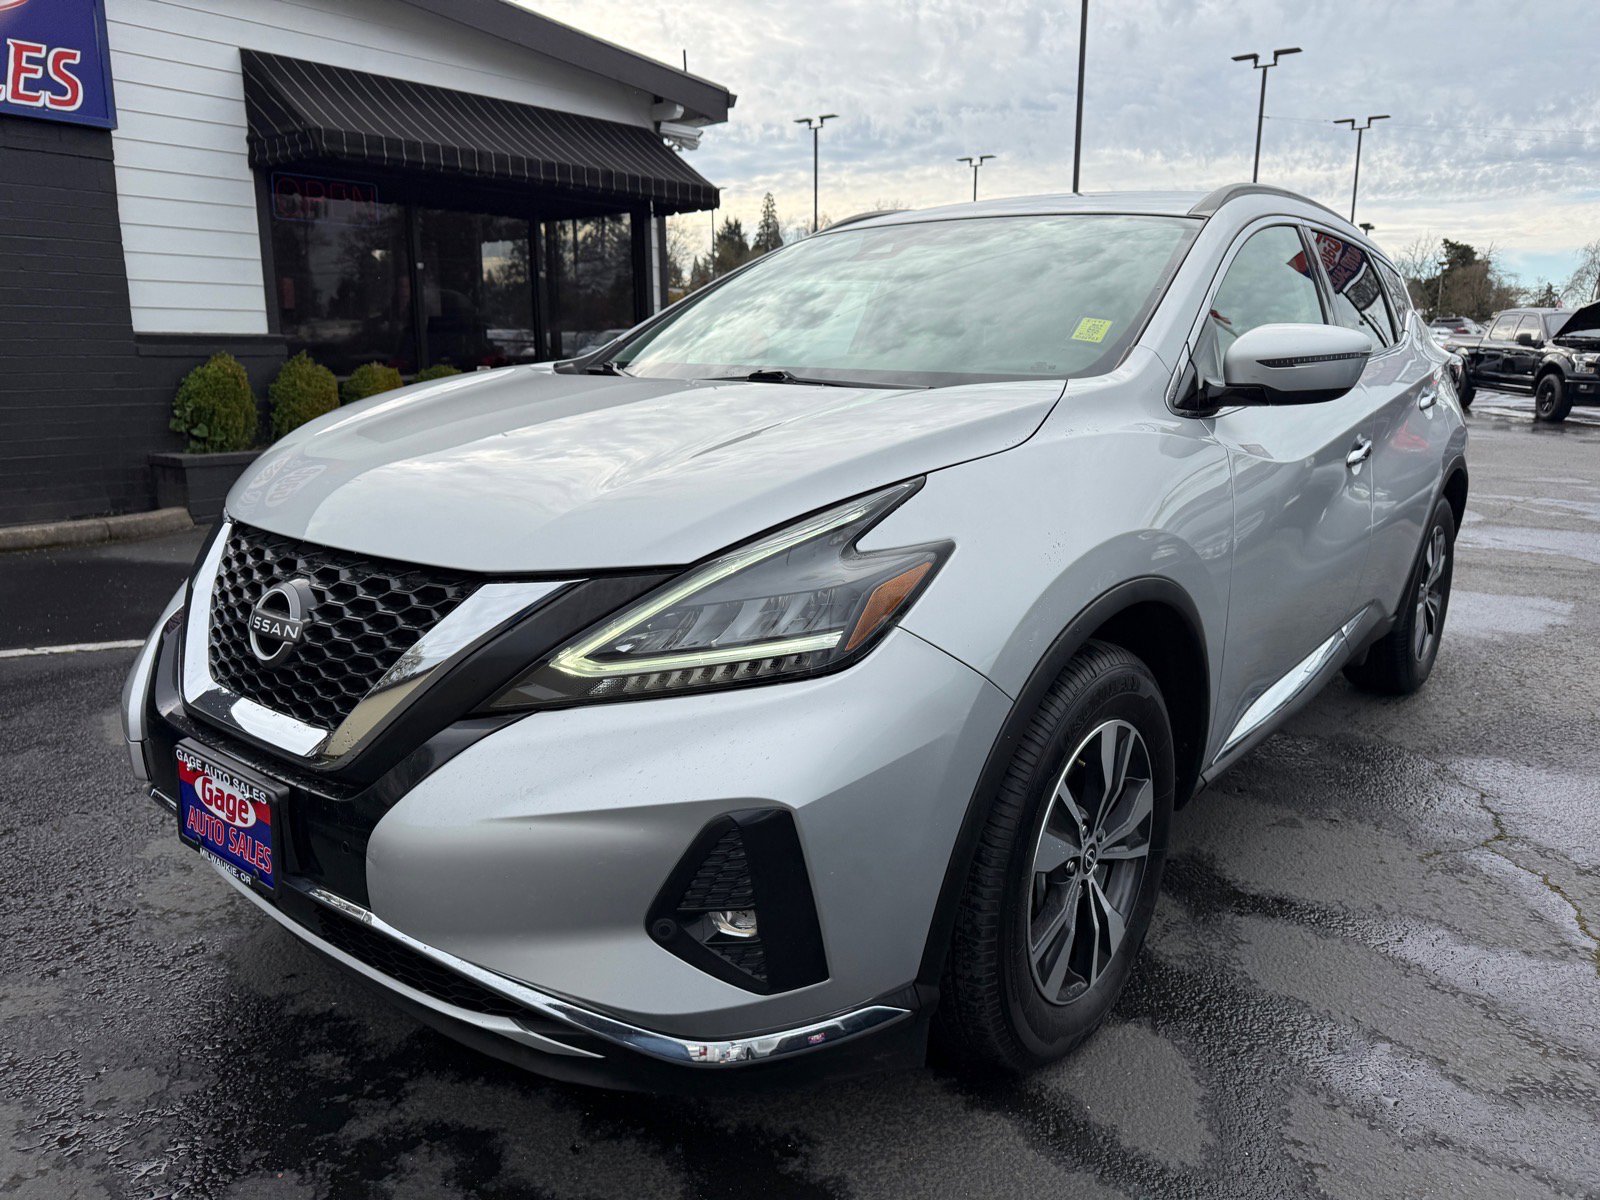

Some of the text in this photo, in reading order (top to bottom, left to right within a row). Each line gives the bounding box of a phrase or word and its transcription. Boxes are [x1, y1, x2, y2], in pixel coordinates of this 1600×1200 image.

[0, 38, 83, 111] ES
[175, 749, 267, 805] GAGE AUTO SALES
[201, 776, 249, 824] Gage
[187, 804, 272, 874] AUTO SALES
[240, 873, 252, 886] OR
